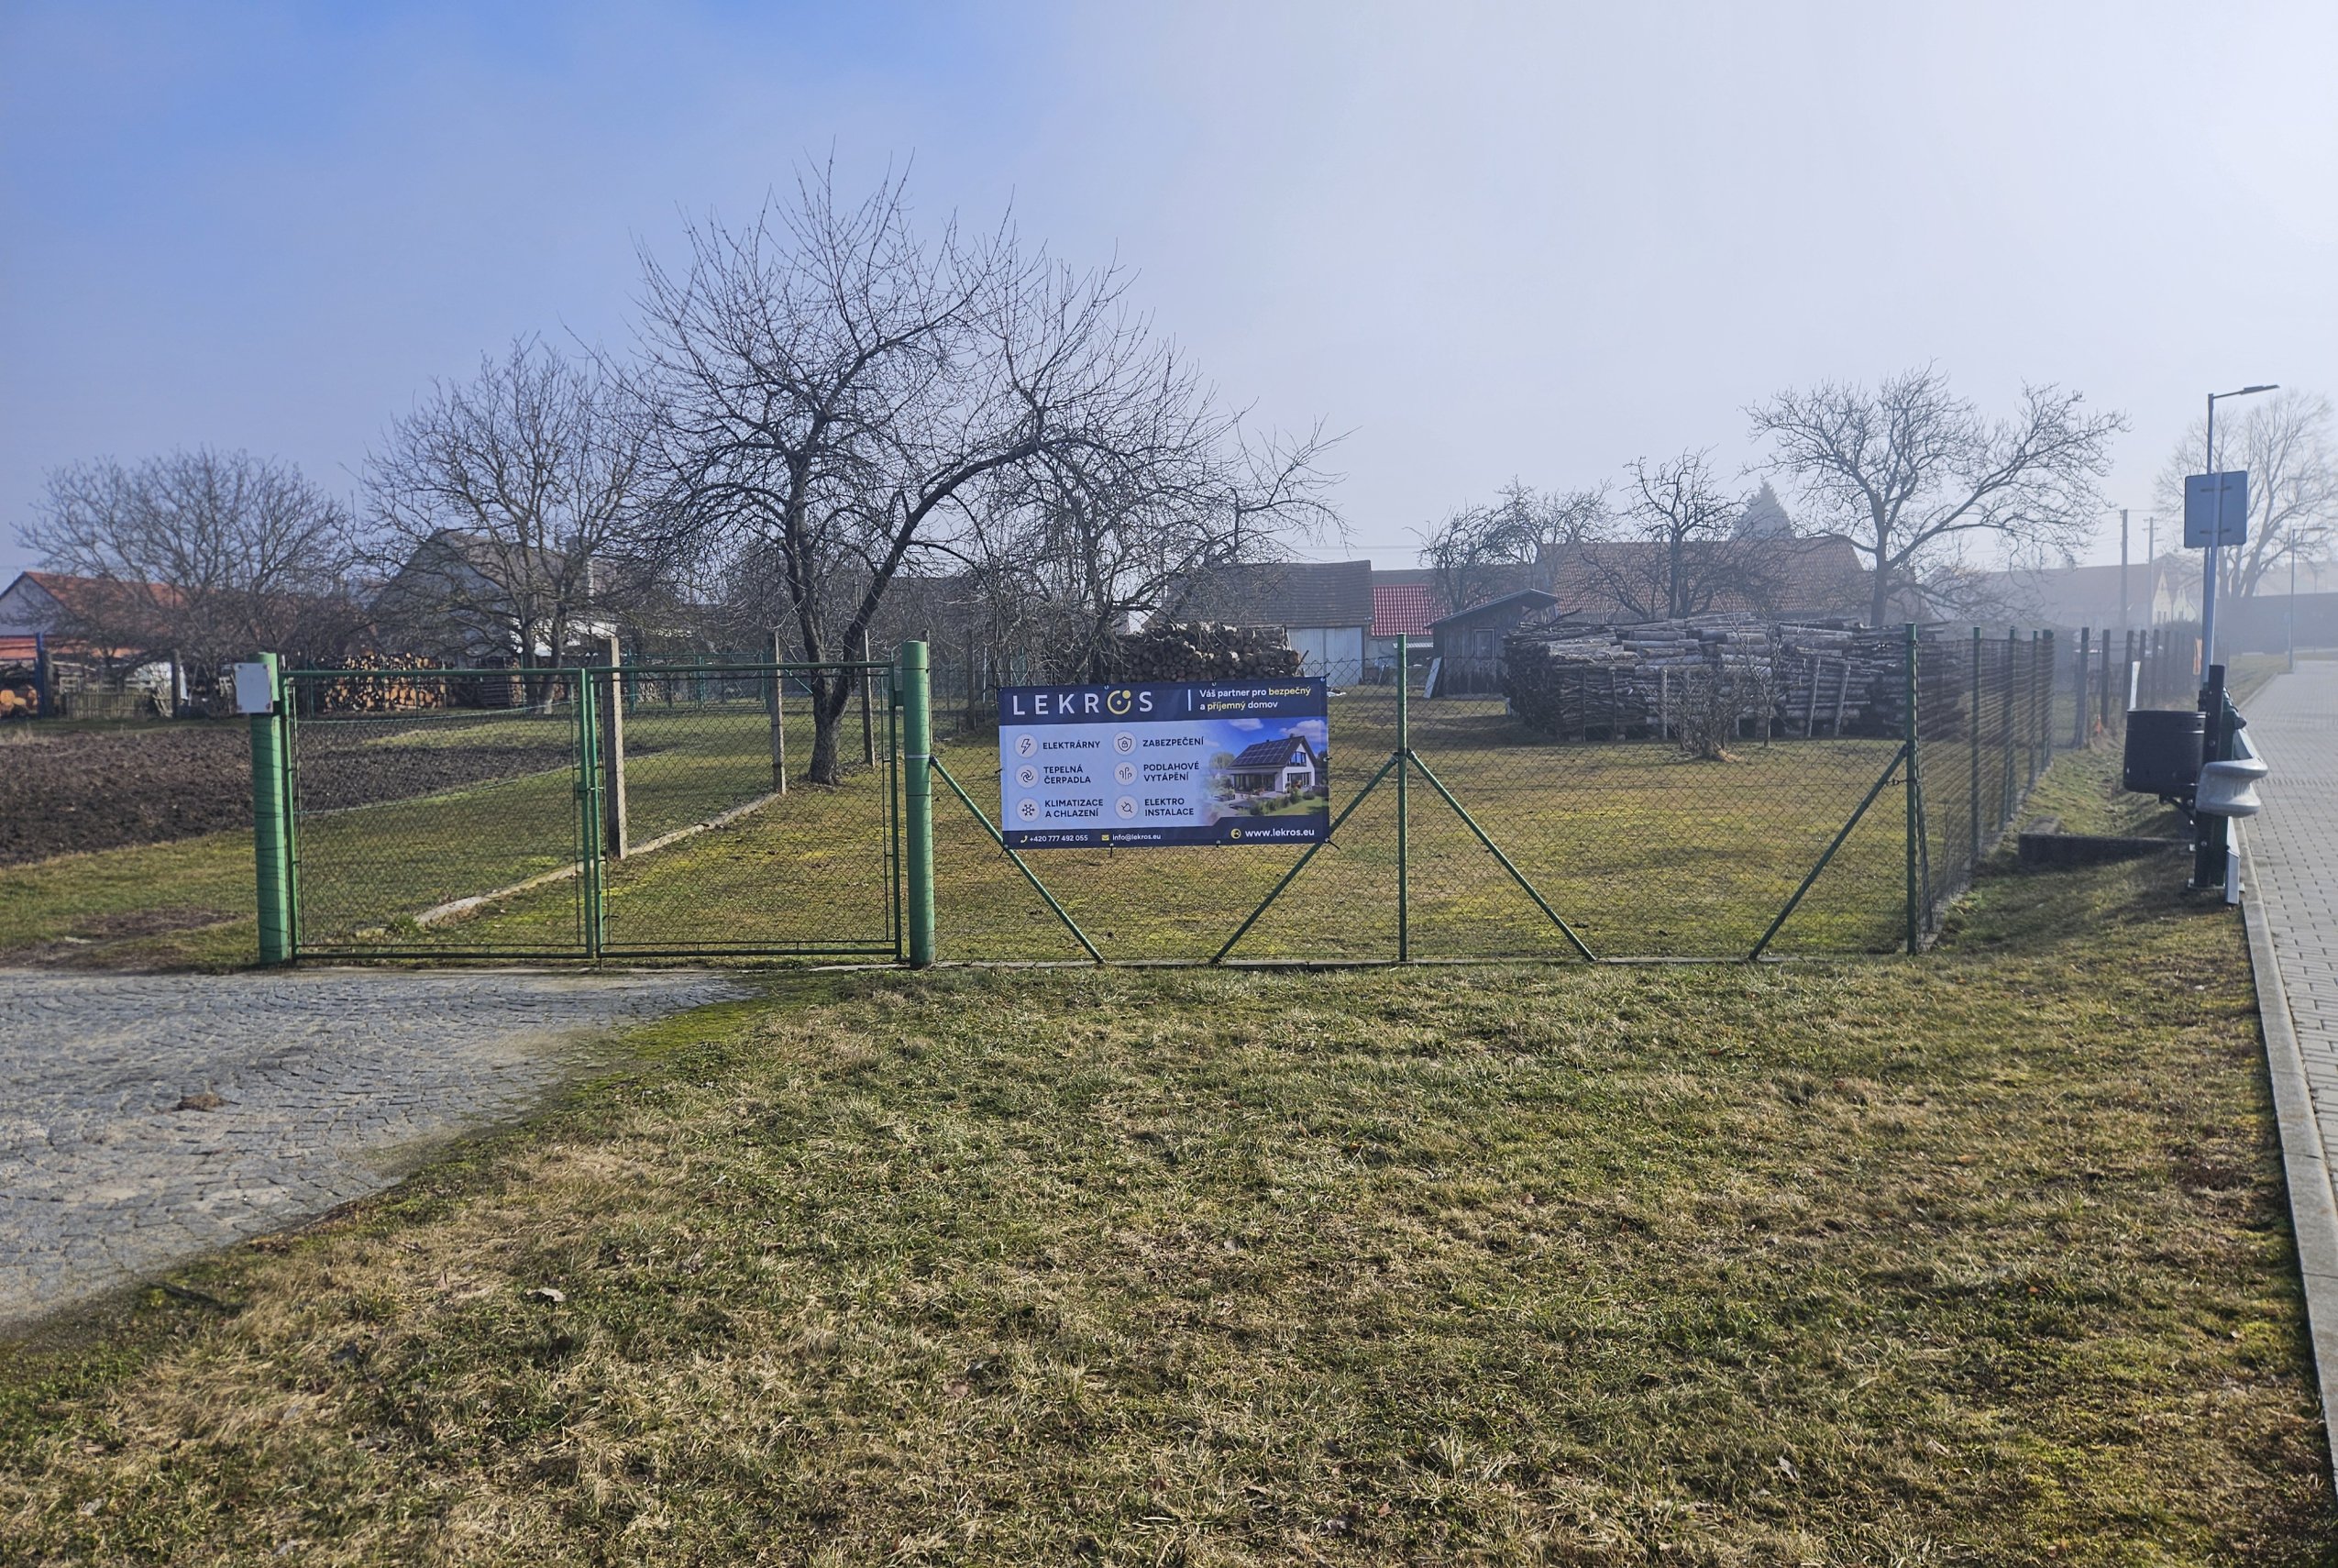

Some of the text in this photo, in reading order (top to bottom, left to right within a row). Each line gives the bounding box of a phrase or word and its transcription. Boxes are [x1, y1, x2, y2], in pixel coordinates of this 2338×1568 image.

[1199, 686, 1311, 700] Váš partner pro bezpečný
[1012, 690, 1153, 714] LEKROS
[1208, 700, 1246, 712] příjemný
[1248, 700, 1278, 709] domov
[1042, 739, 1100, 750] ELEKTRÁRNY
[1142, 736, 1204, 747] ZABEZPEČENÍ
[1043, 765, 1083, 774] TEPELNÁ
[1143, 760, 1199, 771] PODLAHOVÉ
[1043, 773, 1091, 784] ČERPADLA
[1143, 770, 1189, 782] VYTÁPĚNÍ
[1044, 798, 1103, 808] KLIMATIZACE
[1144, 798, 1185, 807] ELEKTRO
[1045, 807, 1098, 818] A CHLAZENÍ
[1144, 807, 1194, 816] INSTALACE
[1112, 833, 1161, 842] info@lekros.eu
[1245, 827, 1315, 838] www.lekros.eu
